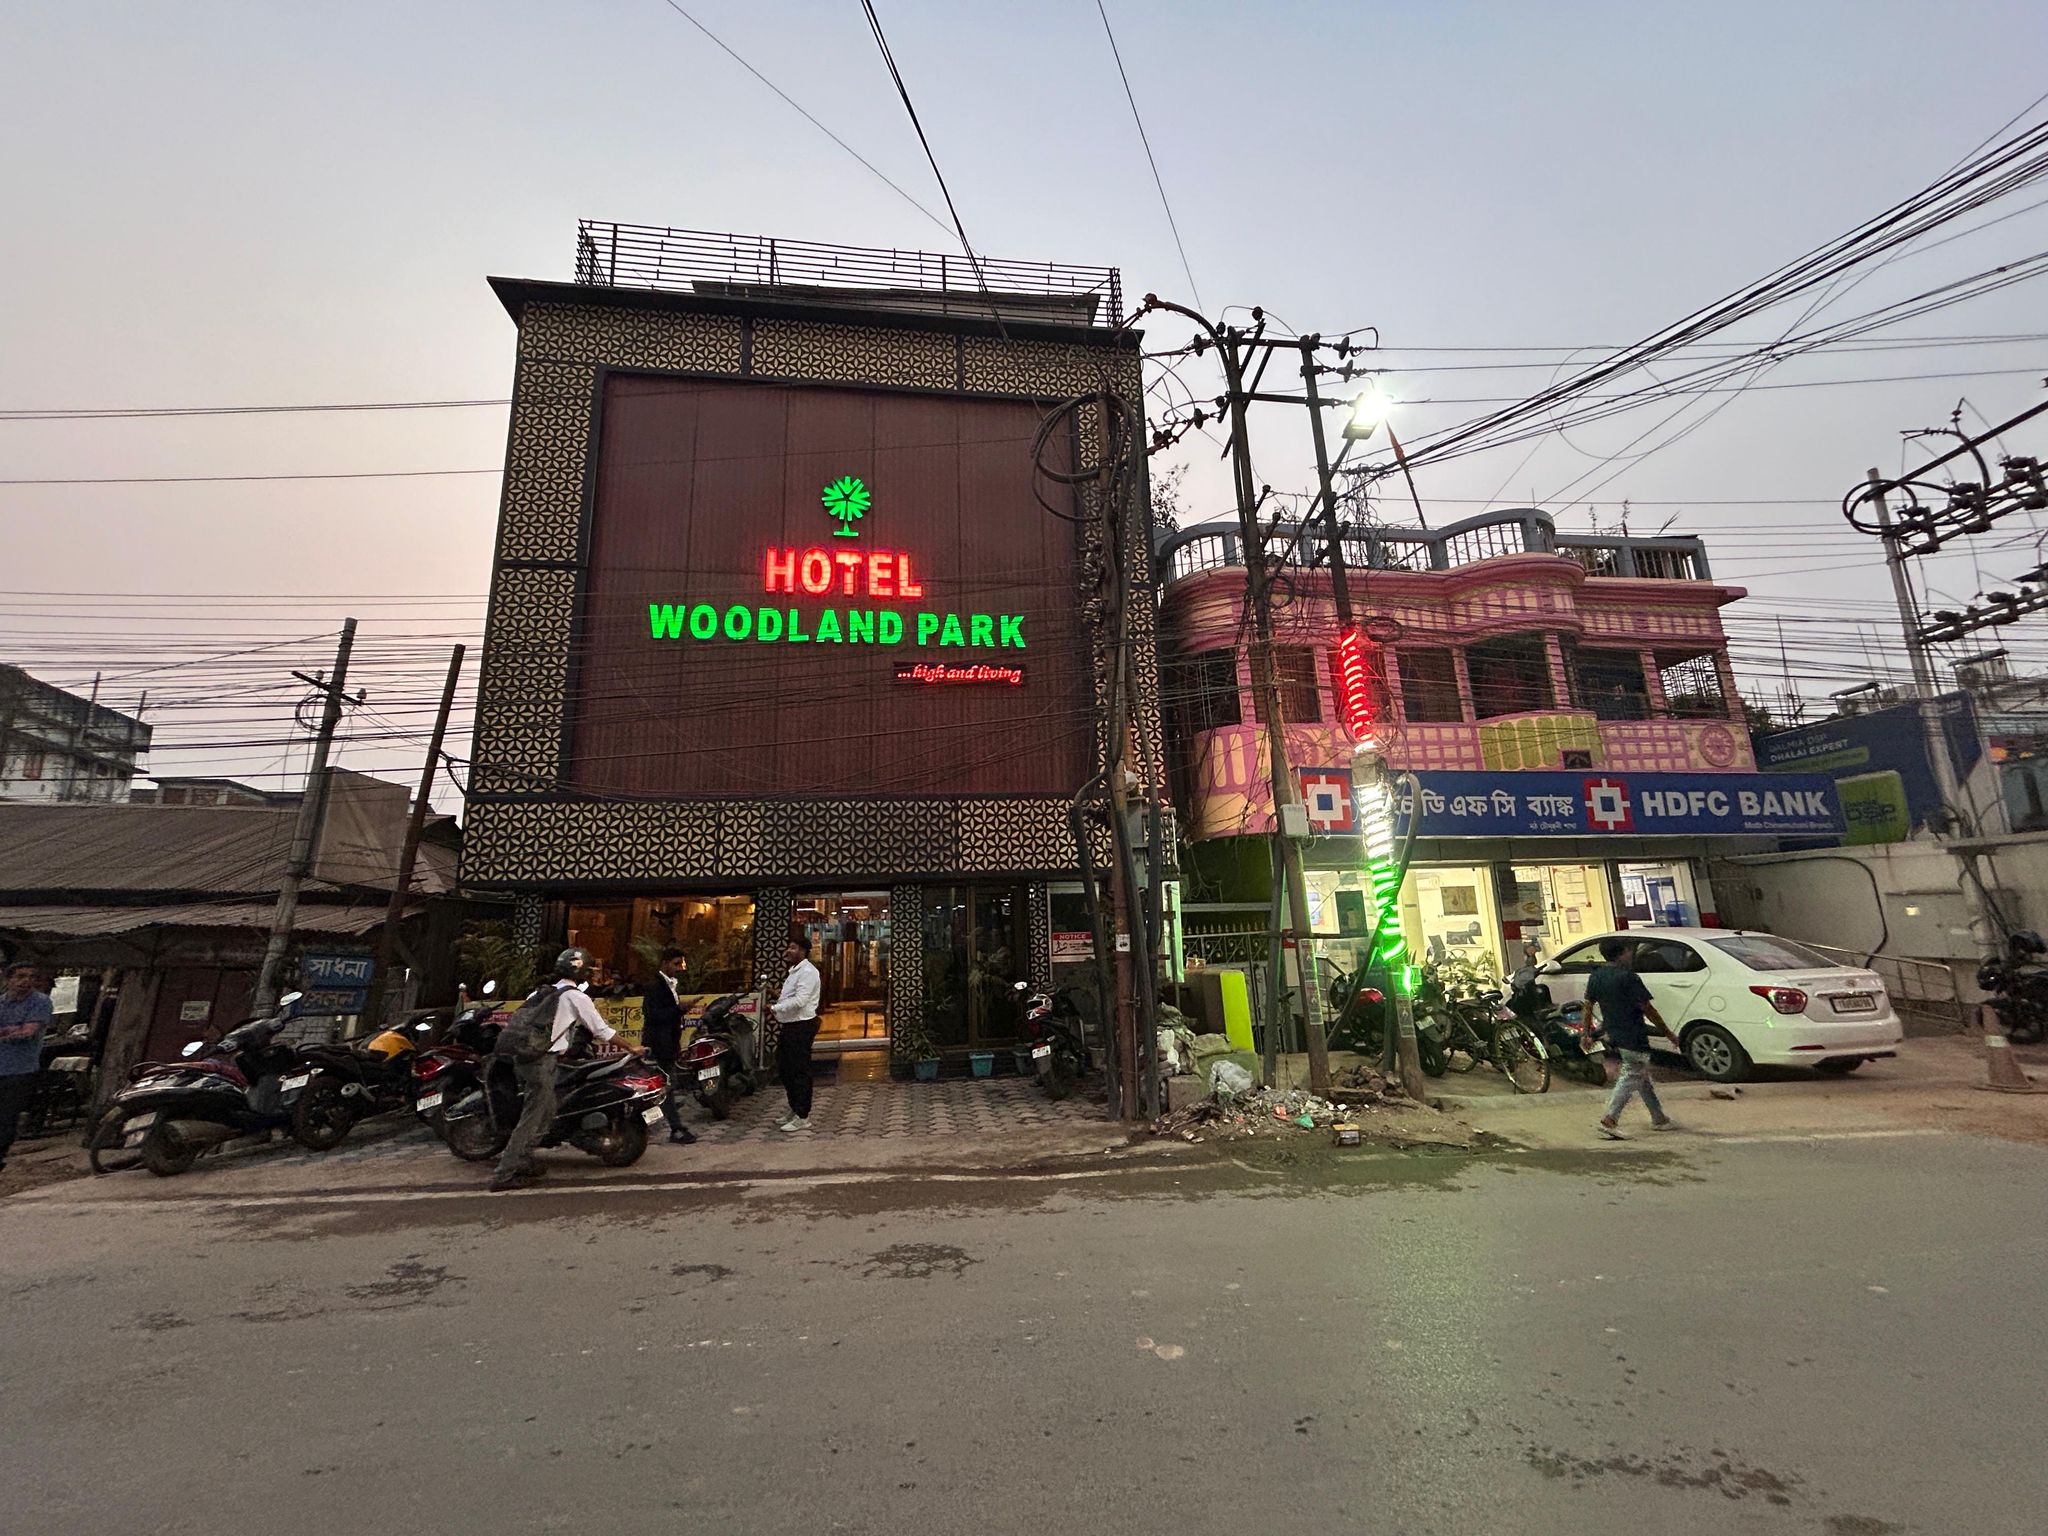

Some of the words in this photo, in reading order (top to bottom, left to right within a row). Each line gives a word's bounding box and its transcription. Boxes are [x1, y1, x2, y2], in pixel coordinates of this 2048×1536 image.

[765, 548, 923, 598] HOTEL
[649, 604, 903, 645] WOODLAND
[917, 613, 1026, 648] PARK
[947, 665, 978, 679] and
[978, 665, 1021, 683] living
[1809, 739, 1848, 755] EXPERT
[1421, 788, 1445, 816] ডি
[1450, 796, 1488, 817] এফ
[1491, 789, 1516, 817] সি
[1641, 791, 1730, 817] HDFC
[1738, 791, 1830, 816] BANK
[309, 957, 368, 979] সাধনা
